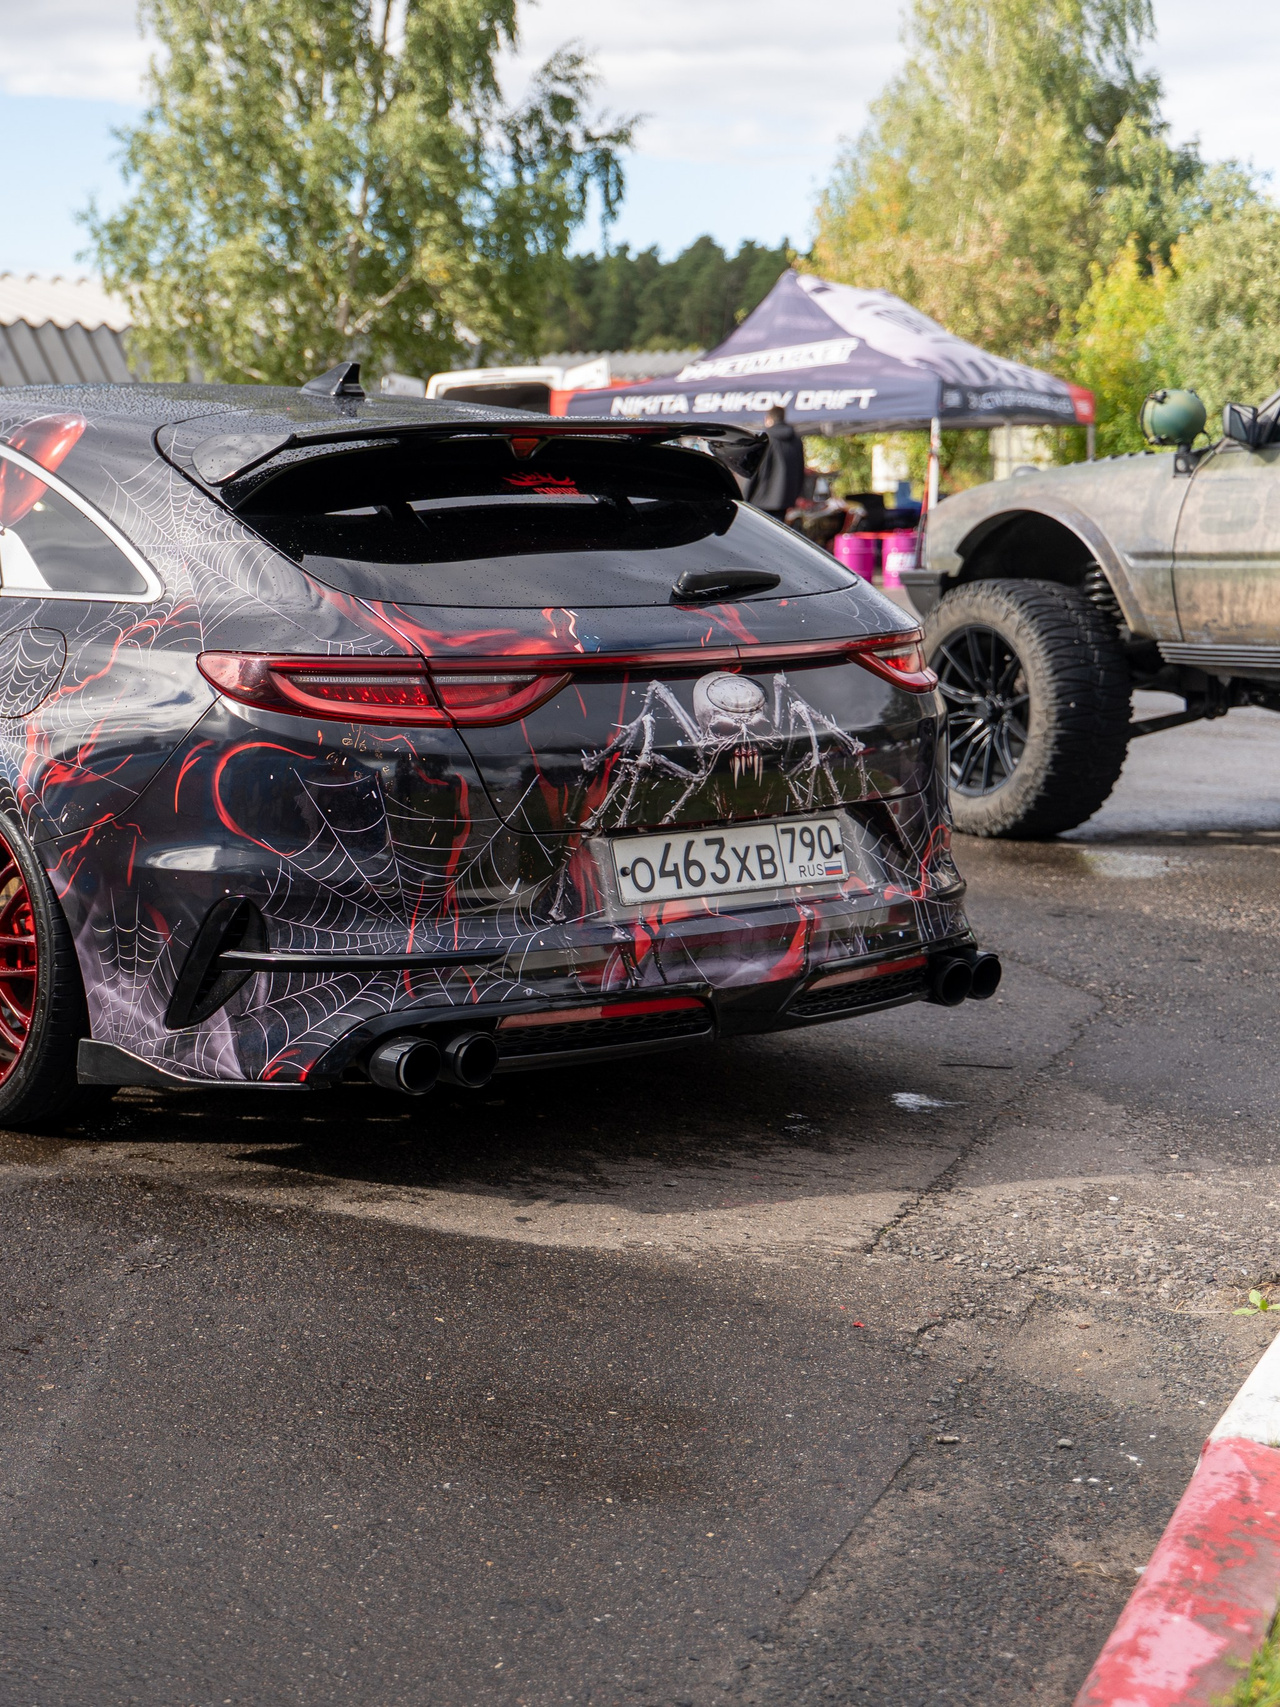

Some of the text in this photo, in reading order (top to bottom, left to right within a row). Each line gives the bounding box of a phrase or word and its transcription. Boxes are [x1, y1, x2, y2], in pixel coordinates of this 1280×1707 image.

[610, 388, 877, 416] NIKITA SHIKOV DRIFT
[780, 824, 835, 864] 790
[798, 863, 825, 878] RUS
